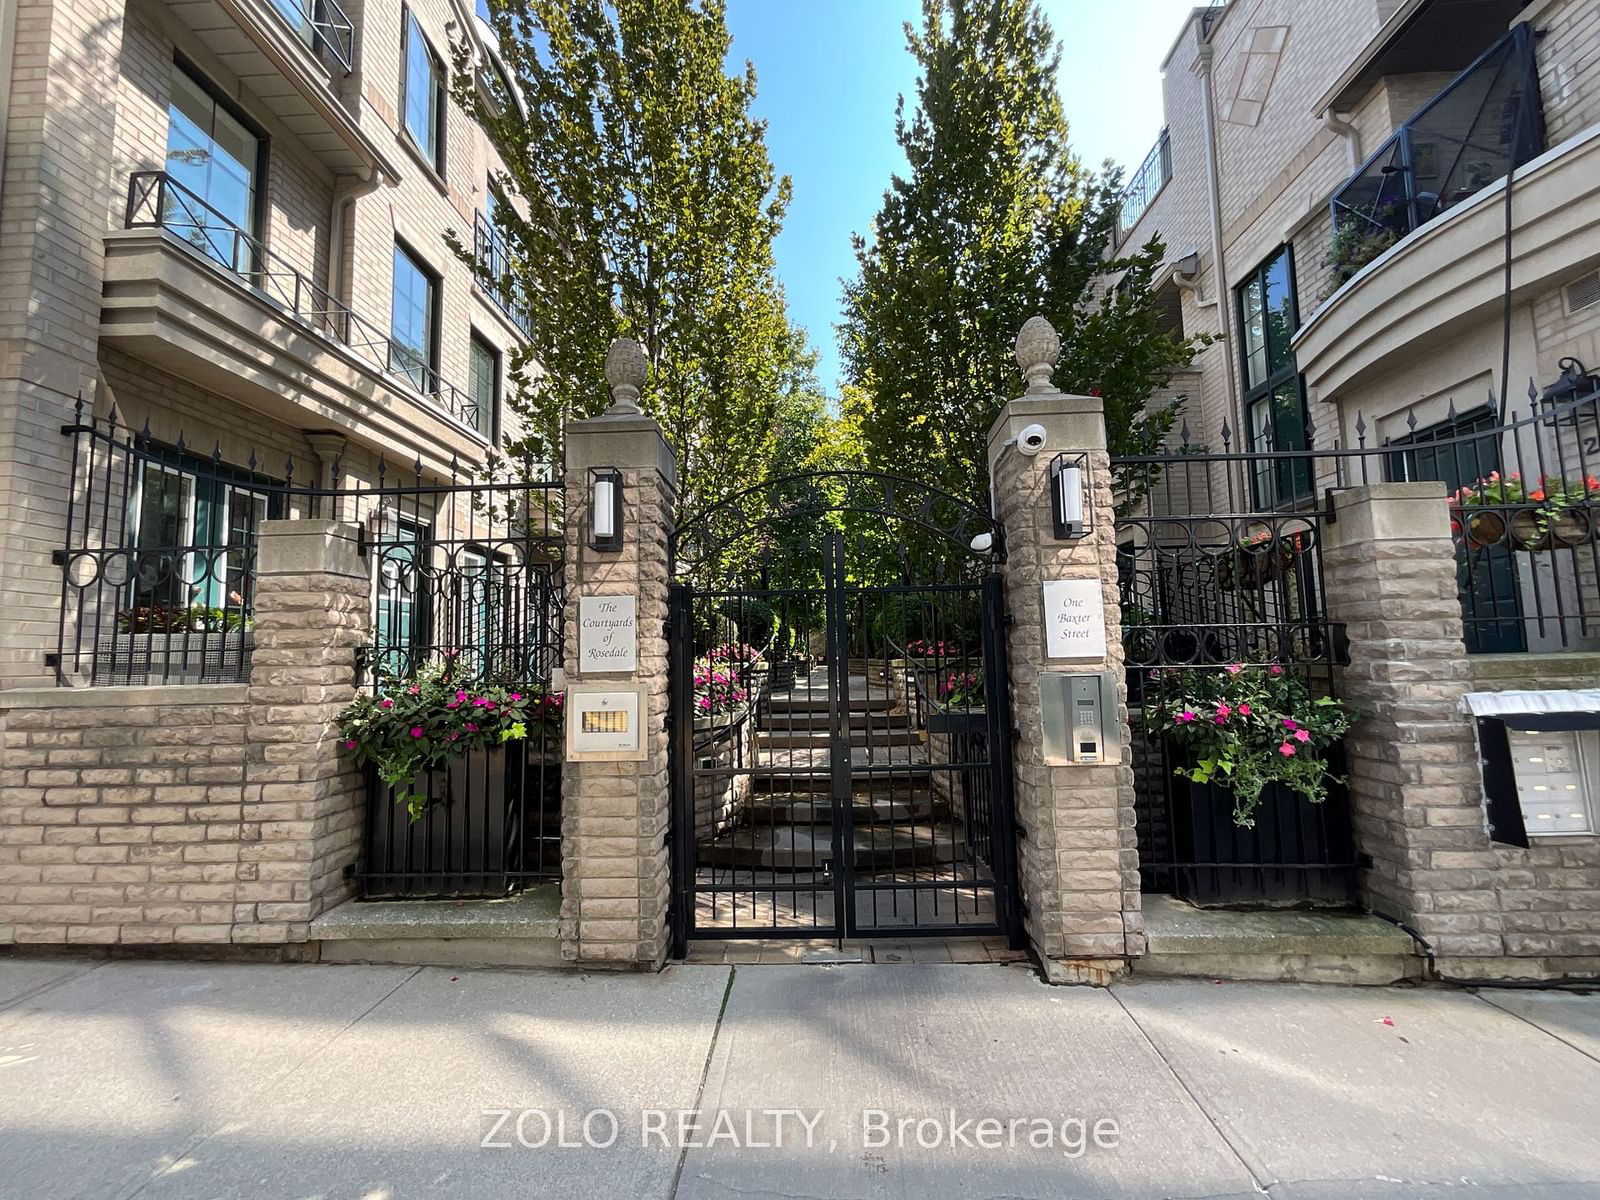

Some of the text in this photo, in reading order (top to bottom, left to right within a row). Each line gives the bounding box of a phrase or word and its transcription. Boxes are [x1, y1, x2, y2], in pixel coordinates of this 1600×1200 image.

[599, 602, 617, 613] The
[1063, 598, 1083, 608] One
[583, 616, 633, 631] Courtyards
[1057, 613, 1091, 625] Baxter
[602, 632, 615, 646] of
[1060, 628, 1089, 640] Street
[588, 647, 628, 659] Rosedale
